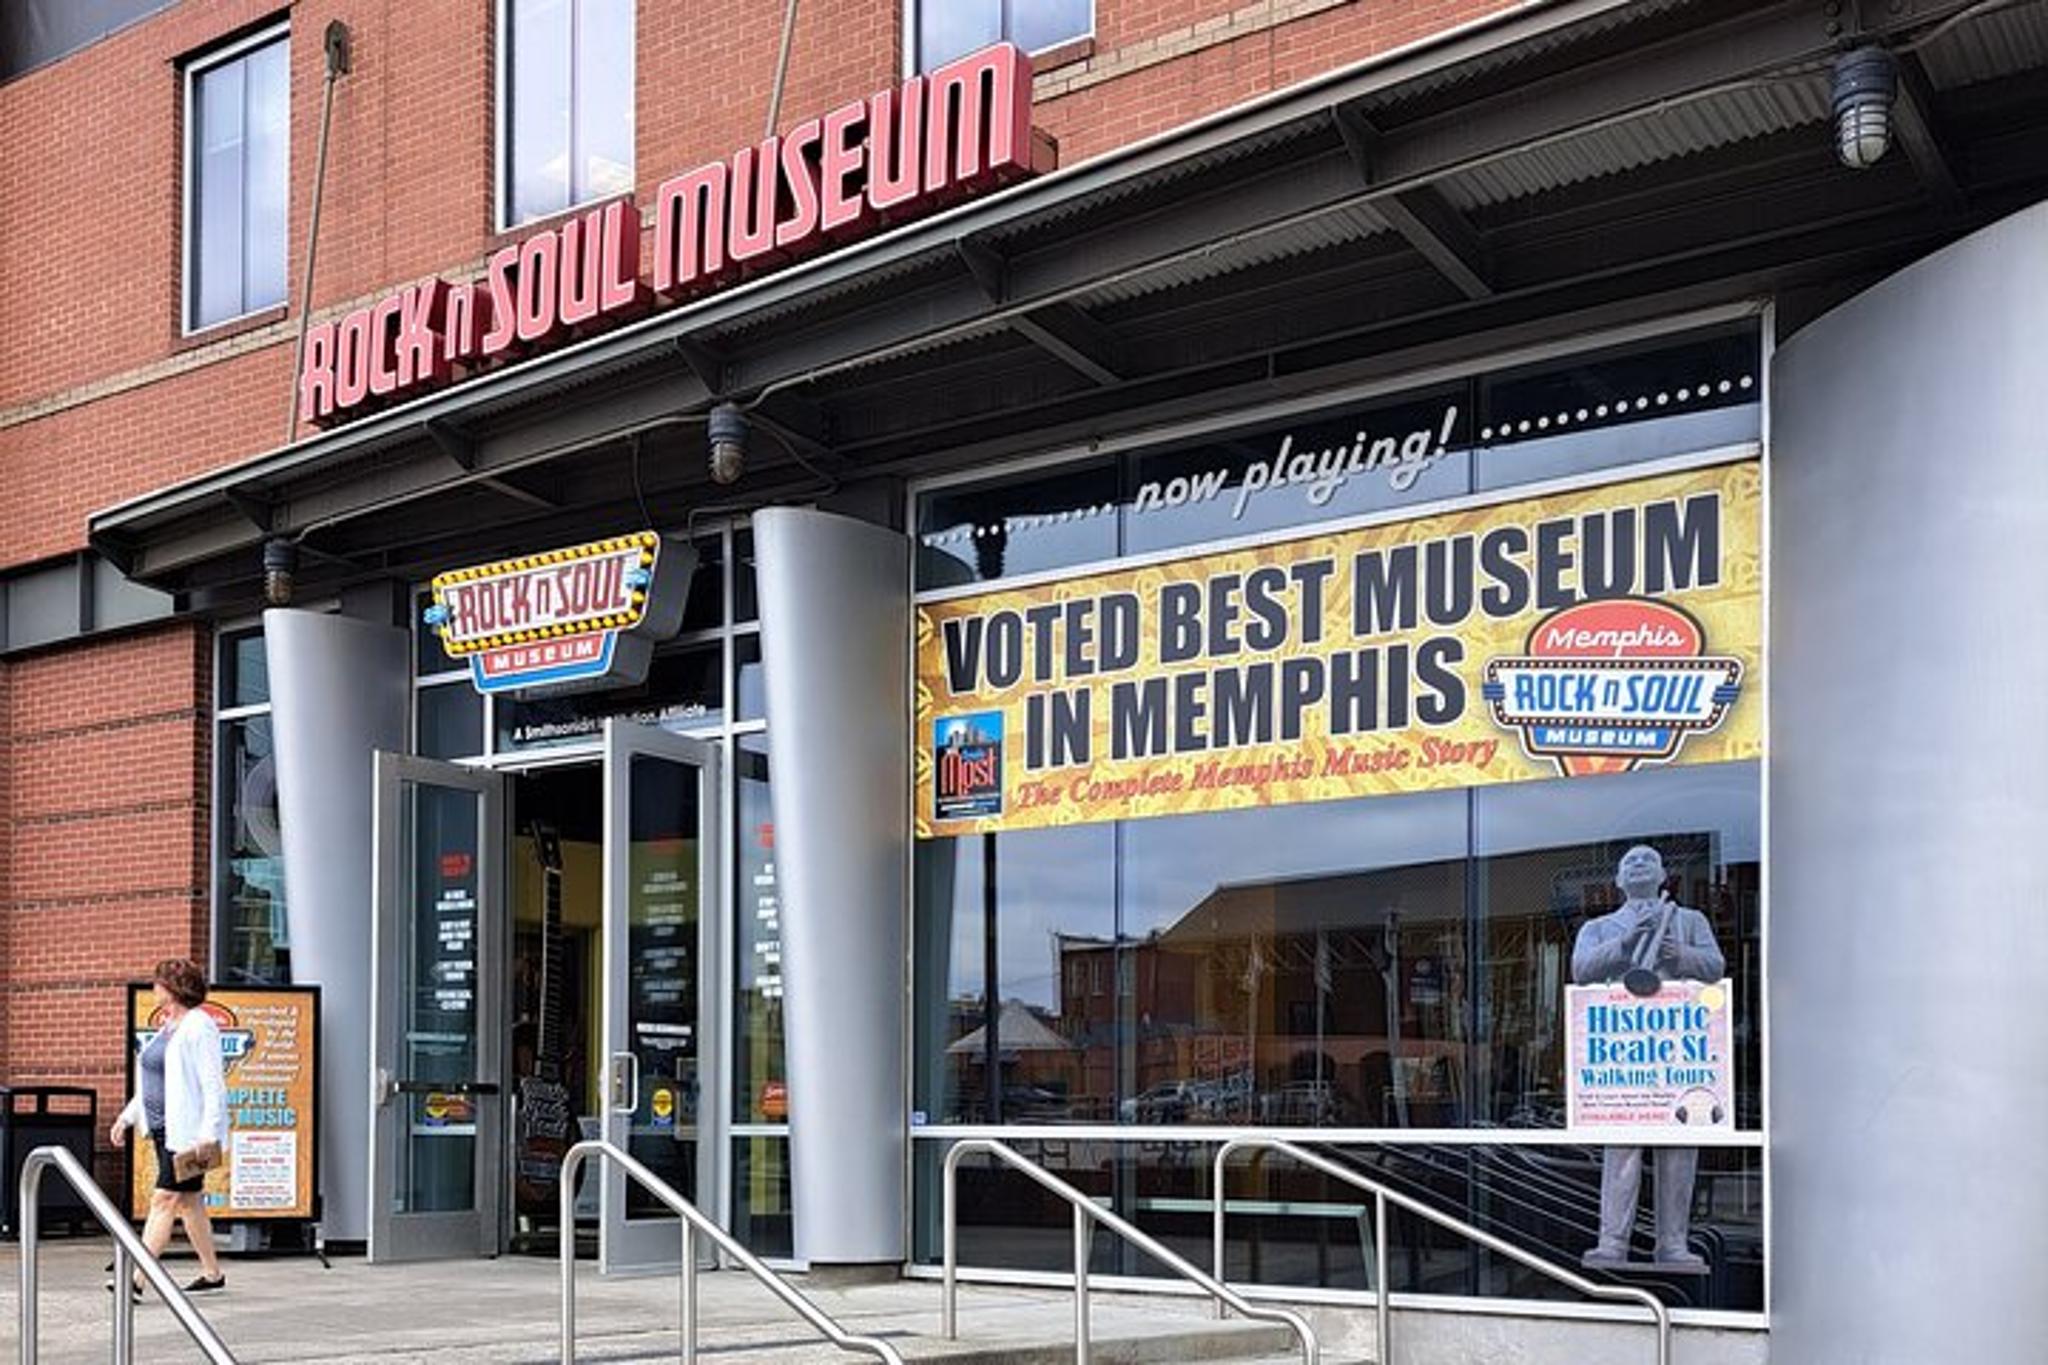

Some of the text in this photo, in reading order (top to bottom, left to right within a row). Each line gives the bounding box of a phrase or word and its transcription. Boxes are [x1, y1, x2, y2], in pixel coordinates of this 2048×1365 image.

[300, 42, 1016, 423] ROCK n SOUL MUSEUM
[1133, 406, 1457, 520] now playing!
[457, 557, 627, 635] ROCK n SOUL
[943, 493, 1720, 694] VOTED BEST MUSEUM
[494, 640, 593, 671] MUSEUM
[1546, 622, 1686, 658] Memphis
[1025, 636, 1466, 770] IN MEMPHIS
[1515, 674, 1705, 713] ROCK n SOUL
[513, 728, 523, 741] A
[1545, 728, 1657, 746] MUSEUM
[1018, 781, 1062, 808] The
[1069, 768, 1183, 804] Complete
[1190, 754, 1313, 793] Memphis
[1321, 742, 1410, 777] Music
[1417, 736, 1499, 769] Story
[1587, 1004, 1710, 1033] Historic
[1588, 1035, 1717, 1065] Beale St.
[1581, 1066, 1717, 1088] Walking Tours
[238, 1108, 297, 1127] MUSIC
